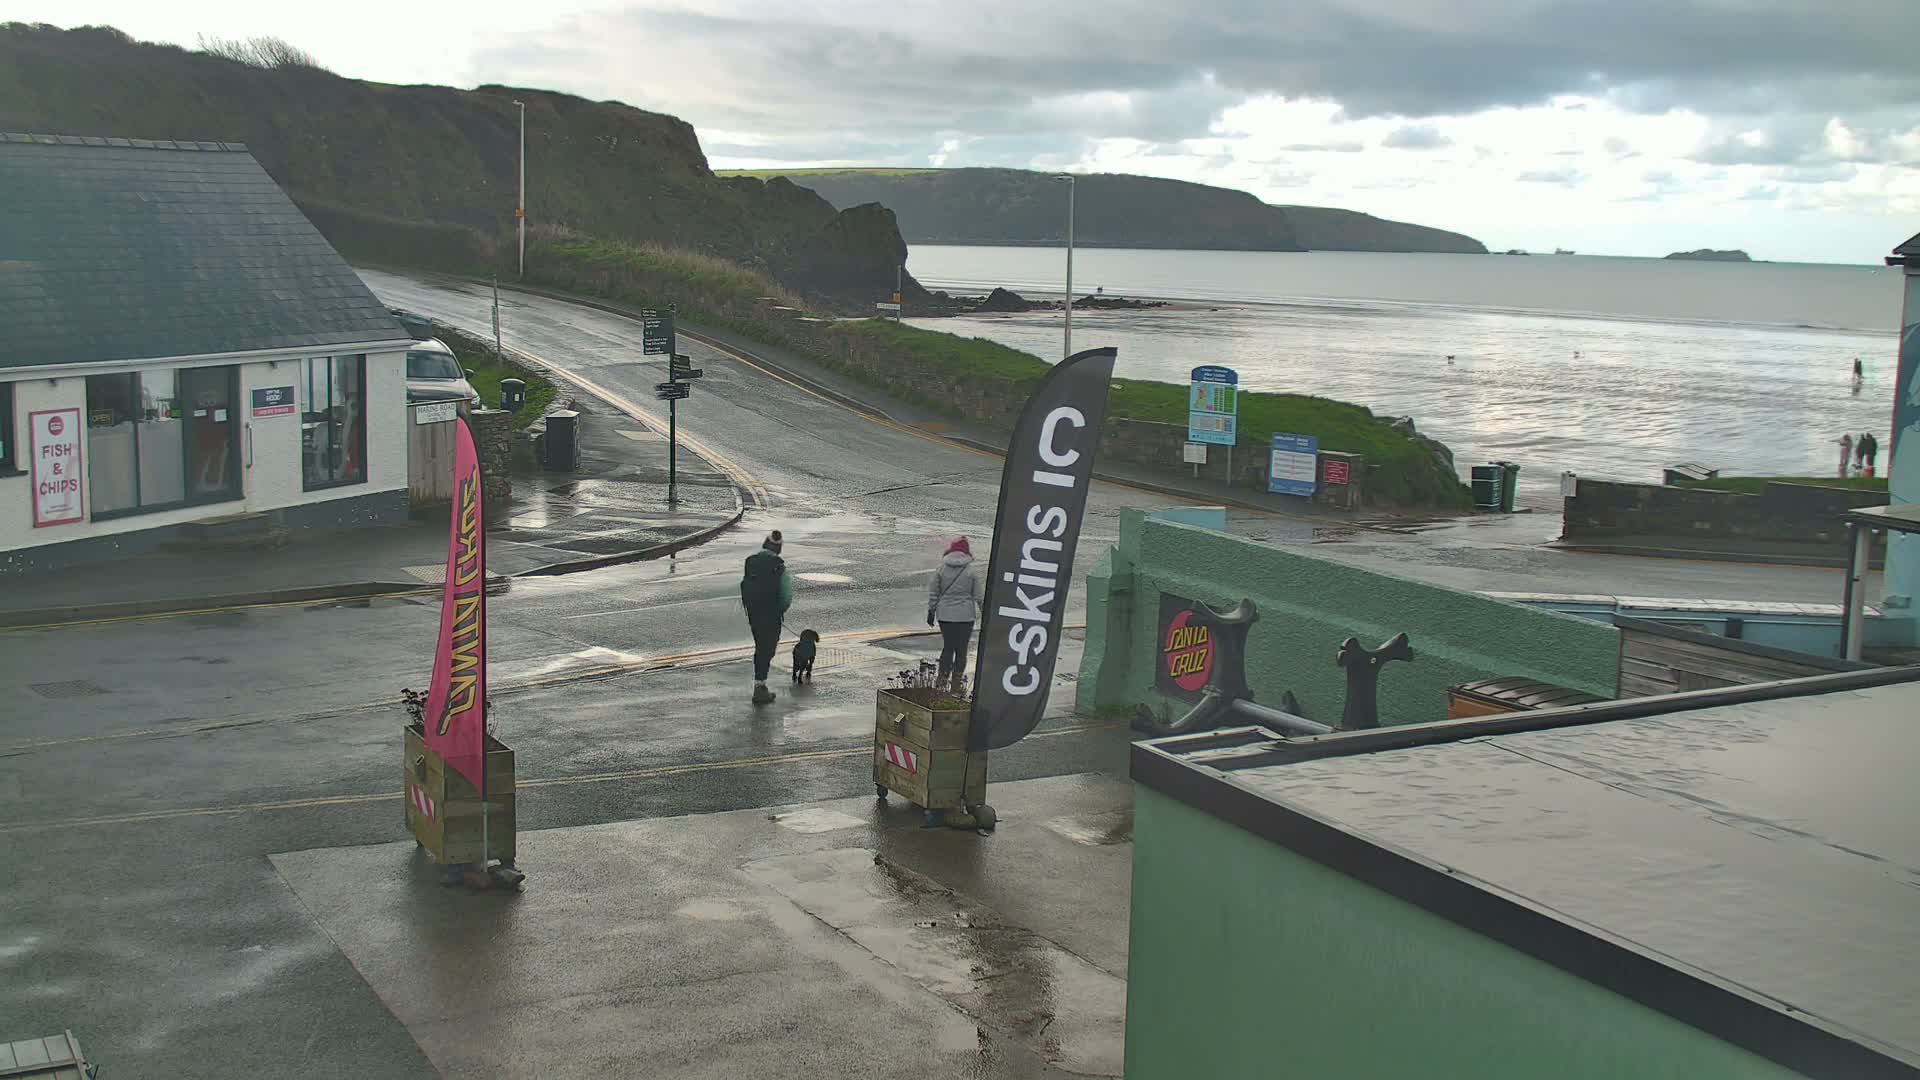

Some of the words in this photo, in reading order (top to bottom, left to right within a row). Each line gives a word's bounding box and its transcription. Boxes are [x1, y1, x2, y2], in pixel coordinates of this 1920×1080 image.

[440, 402, 456, 411] ROAD
[42, 443, 72, 459] FISH
[53, 462, 63, 475] &
[40, 478, 78, 496] CHIPS
[1164, 624, 1208, 652] SANTA
[1169, 648, 1208, 677] CRUZ
